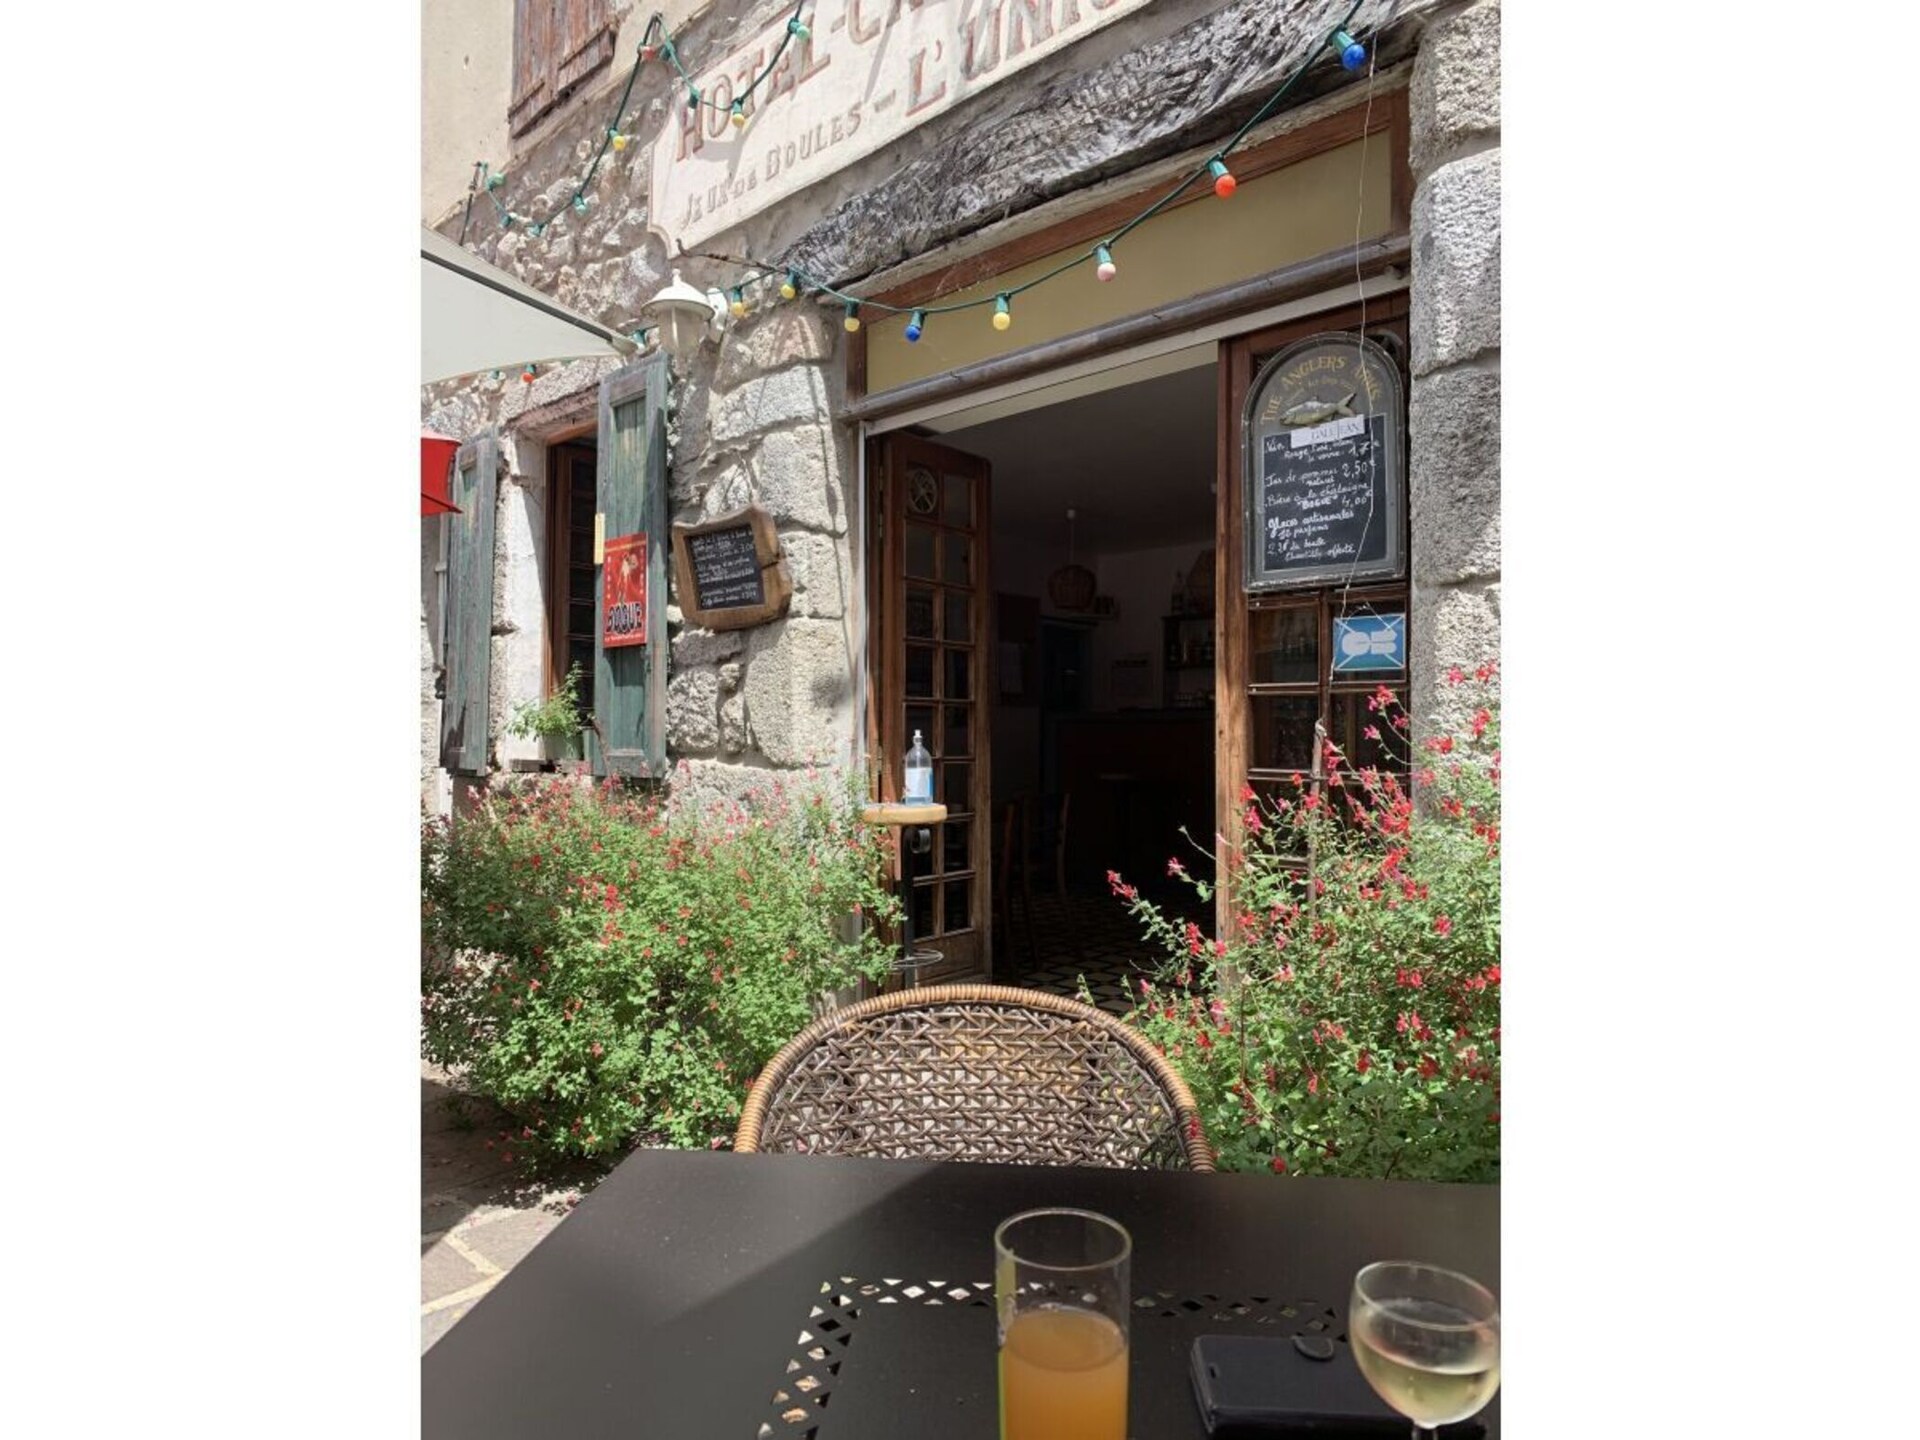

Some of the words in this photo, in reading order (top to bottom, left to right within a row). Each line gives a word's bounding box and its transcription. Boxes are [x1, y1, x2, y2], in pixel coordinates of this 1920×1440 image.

[765, 101, 864, 181] BOULES
[1261, 394, 1282, 424] THE
[1281, 355, 1347, 385] ANGLERS
